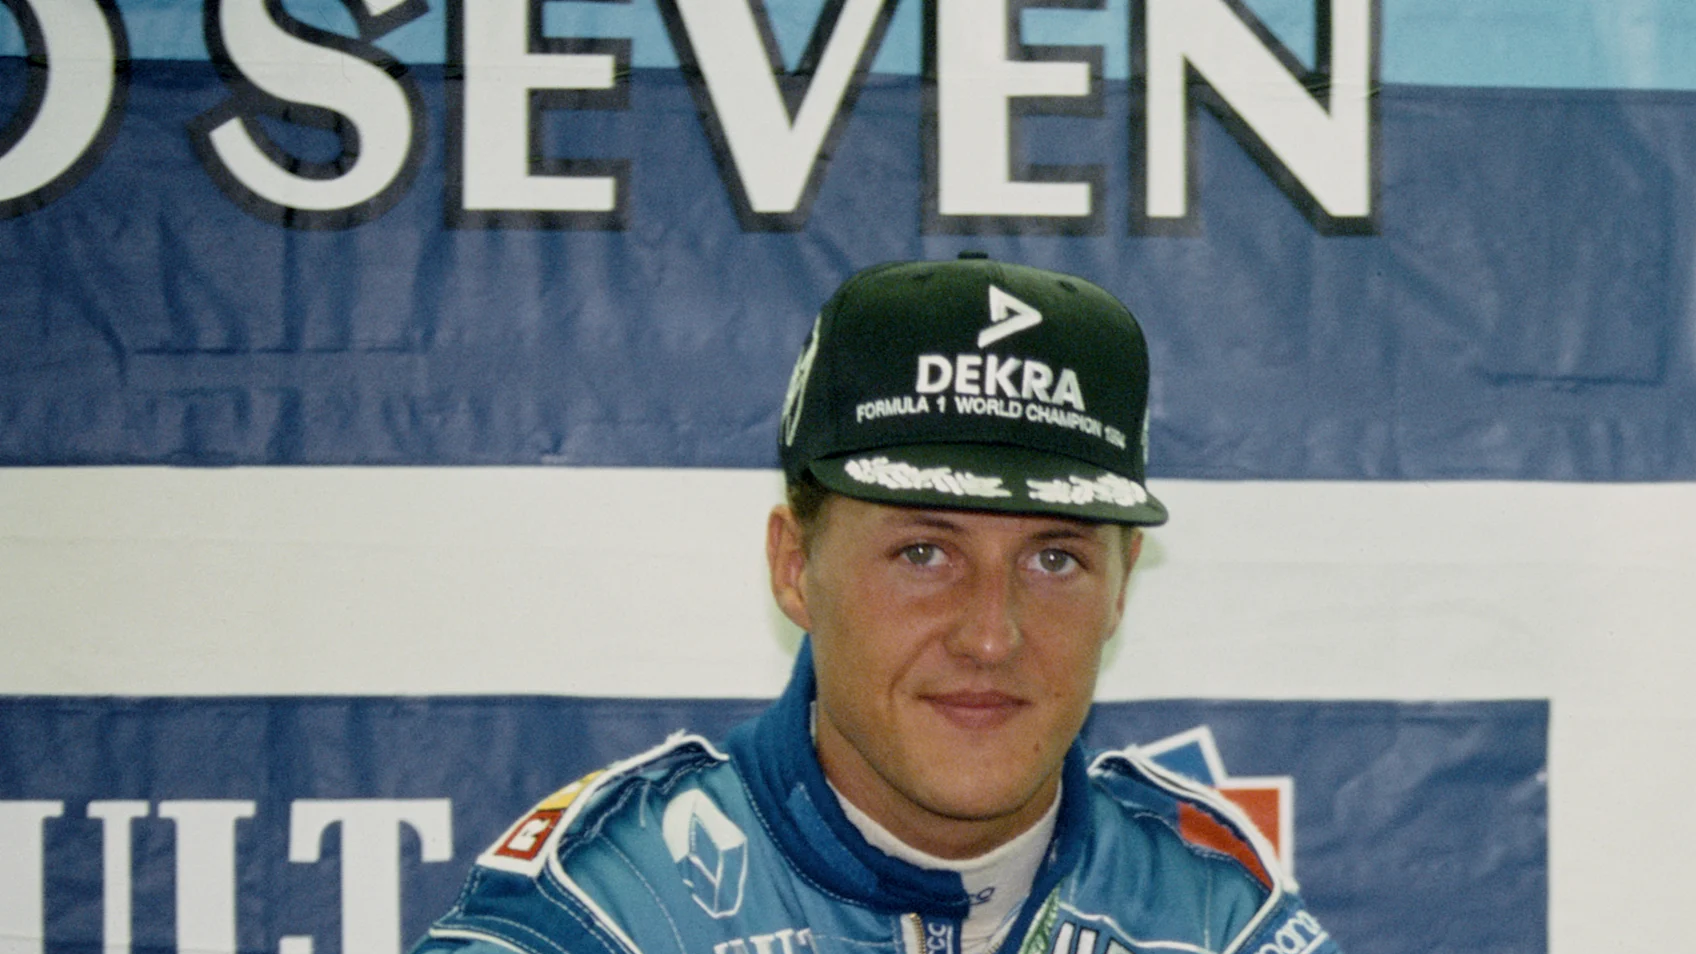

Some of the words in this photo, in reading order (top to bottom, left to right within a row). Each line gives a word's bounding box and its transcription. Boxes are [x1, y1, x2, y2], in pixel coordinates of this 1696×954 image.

[200, 0, 1376, 226] SEVEN
[915, 354, 1086, 412] DEKRA
[856, 396, 930, 423] FORMULA
[936, 396, 946, 414] 1
[954, 396, 1022, 419] WORLD
[1025, 403, 1101, 438] CHAMPION
